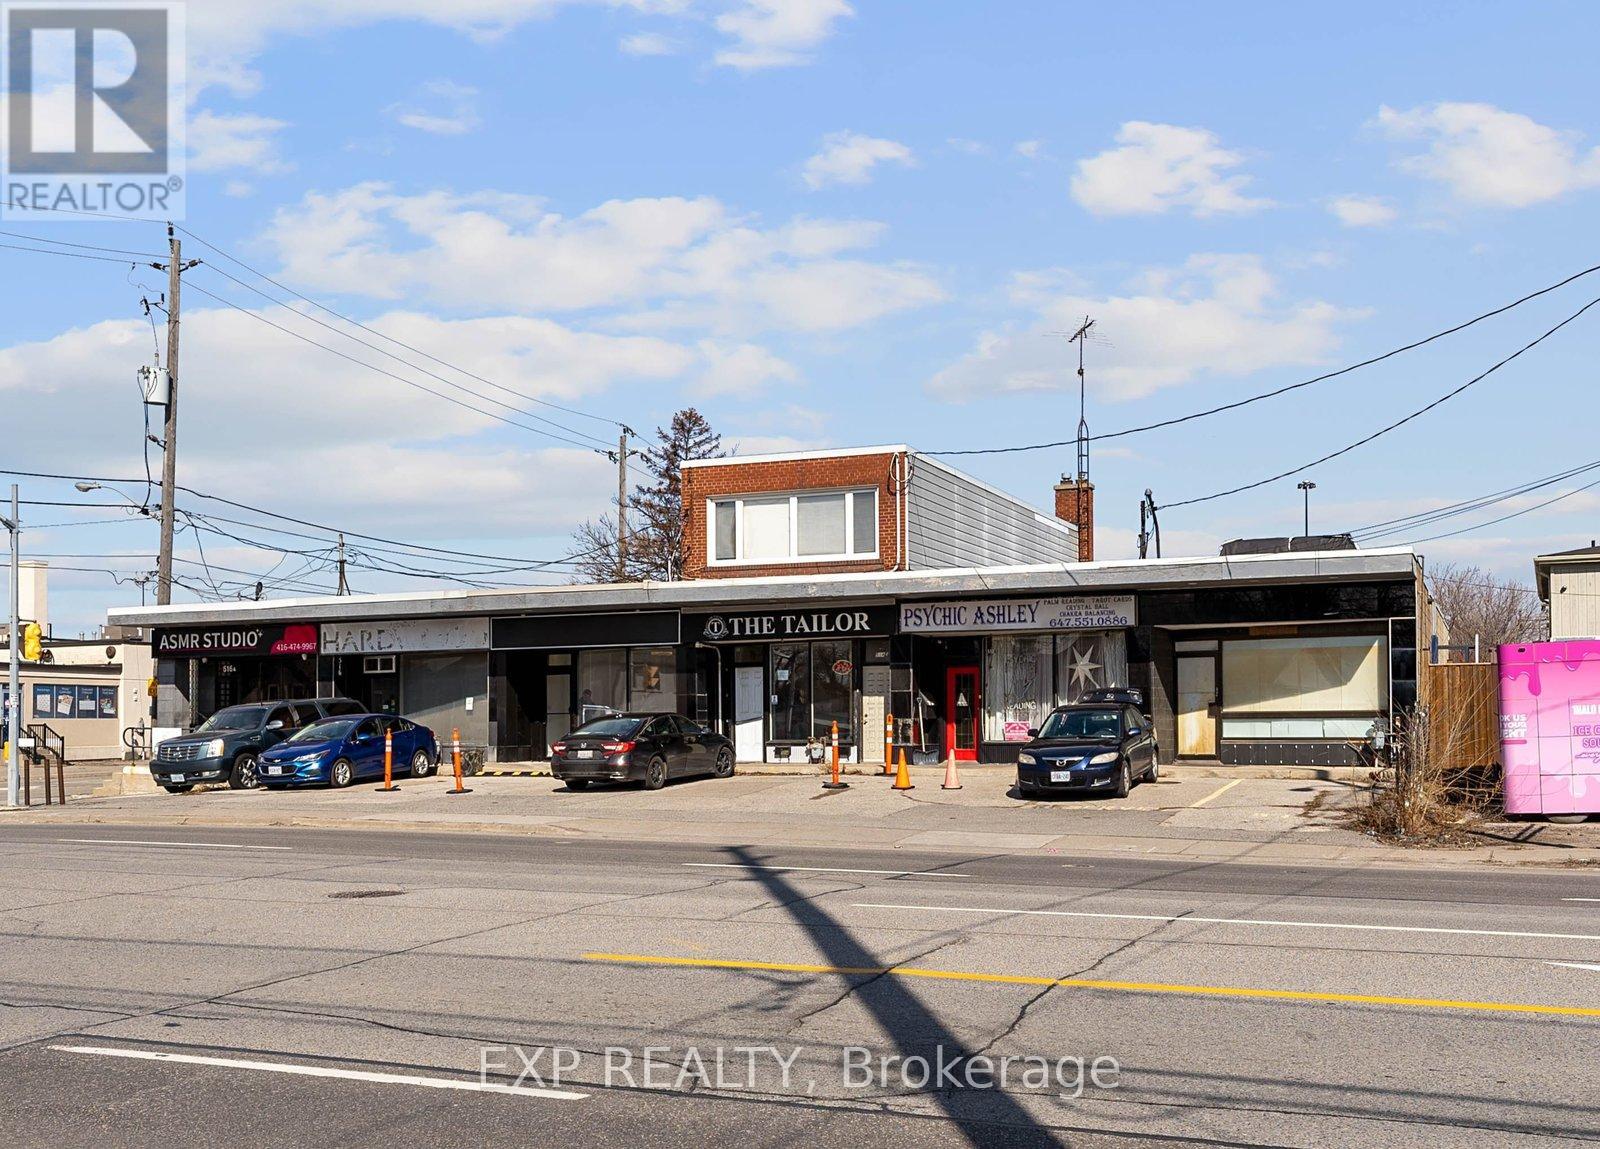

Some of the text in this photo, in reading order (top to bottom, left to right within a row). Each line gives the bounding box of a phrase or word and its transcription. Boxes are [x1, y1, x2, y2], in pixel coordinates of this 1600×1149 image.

[903, 600, 1040, 627] PSYCHIC ASHLEY
[728, 612, 871, 636] THE TAILOR
[1049, 616, 1128, 627] 647.551.0886
[159, 631, 258, 650] ASMR STUDIO
[276, 642, 317, 651] 416-474-9967
[1513, 713, 1527, 722] US
[1573, 725, 1591, 736] ICE
